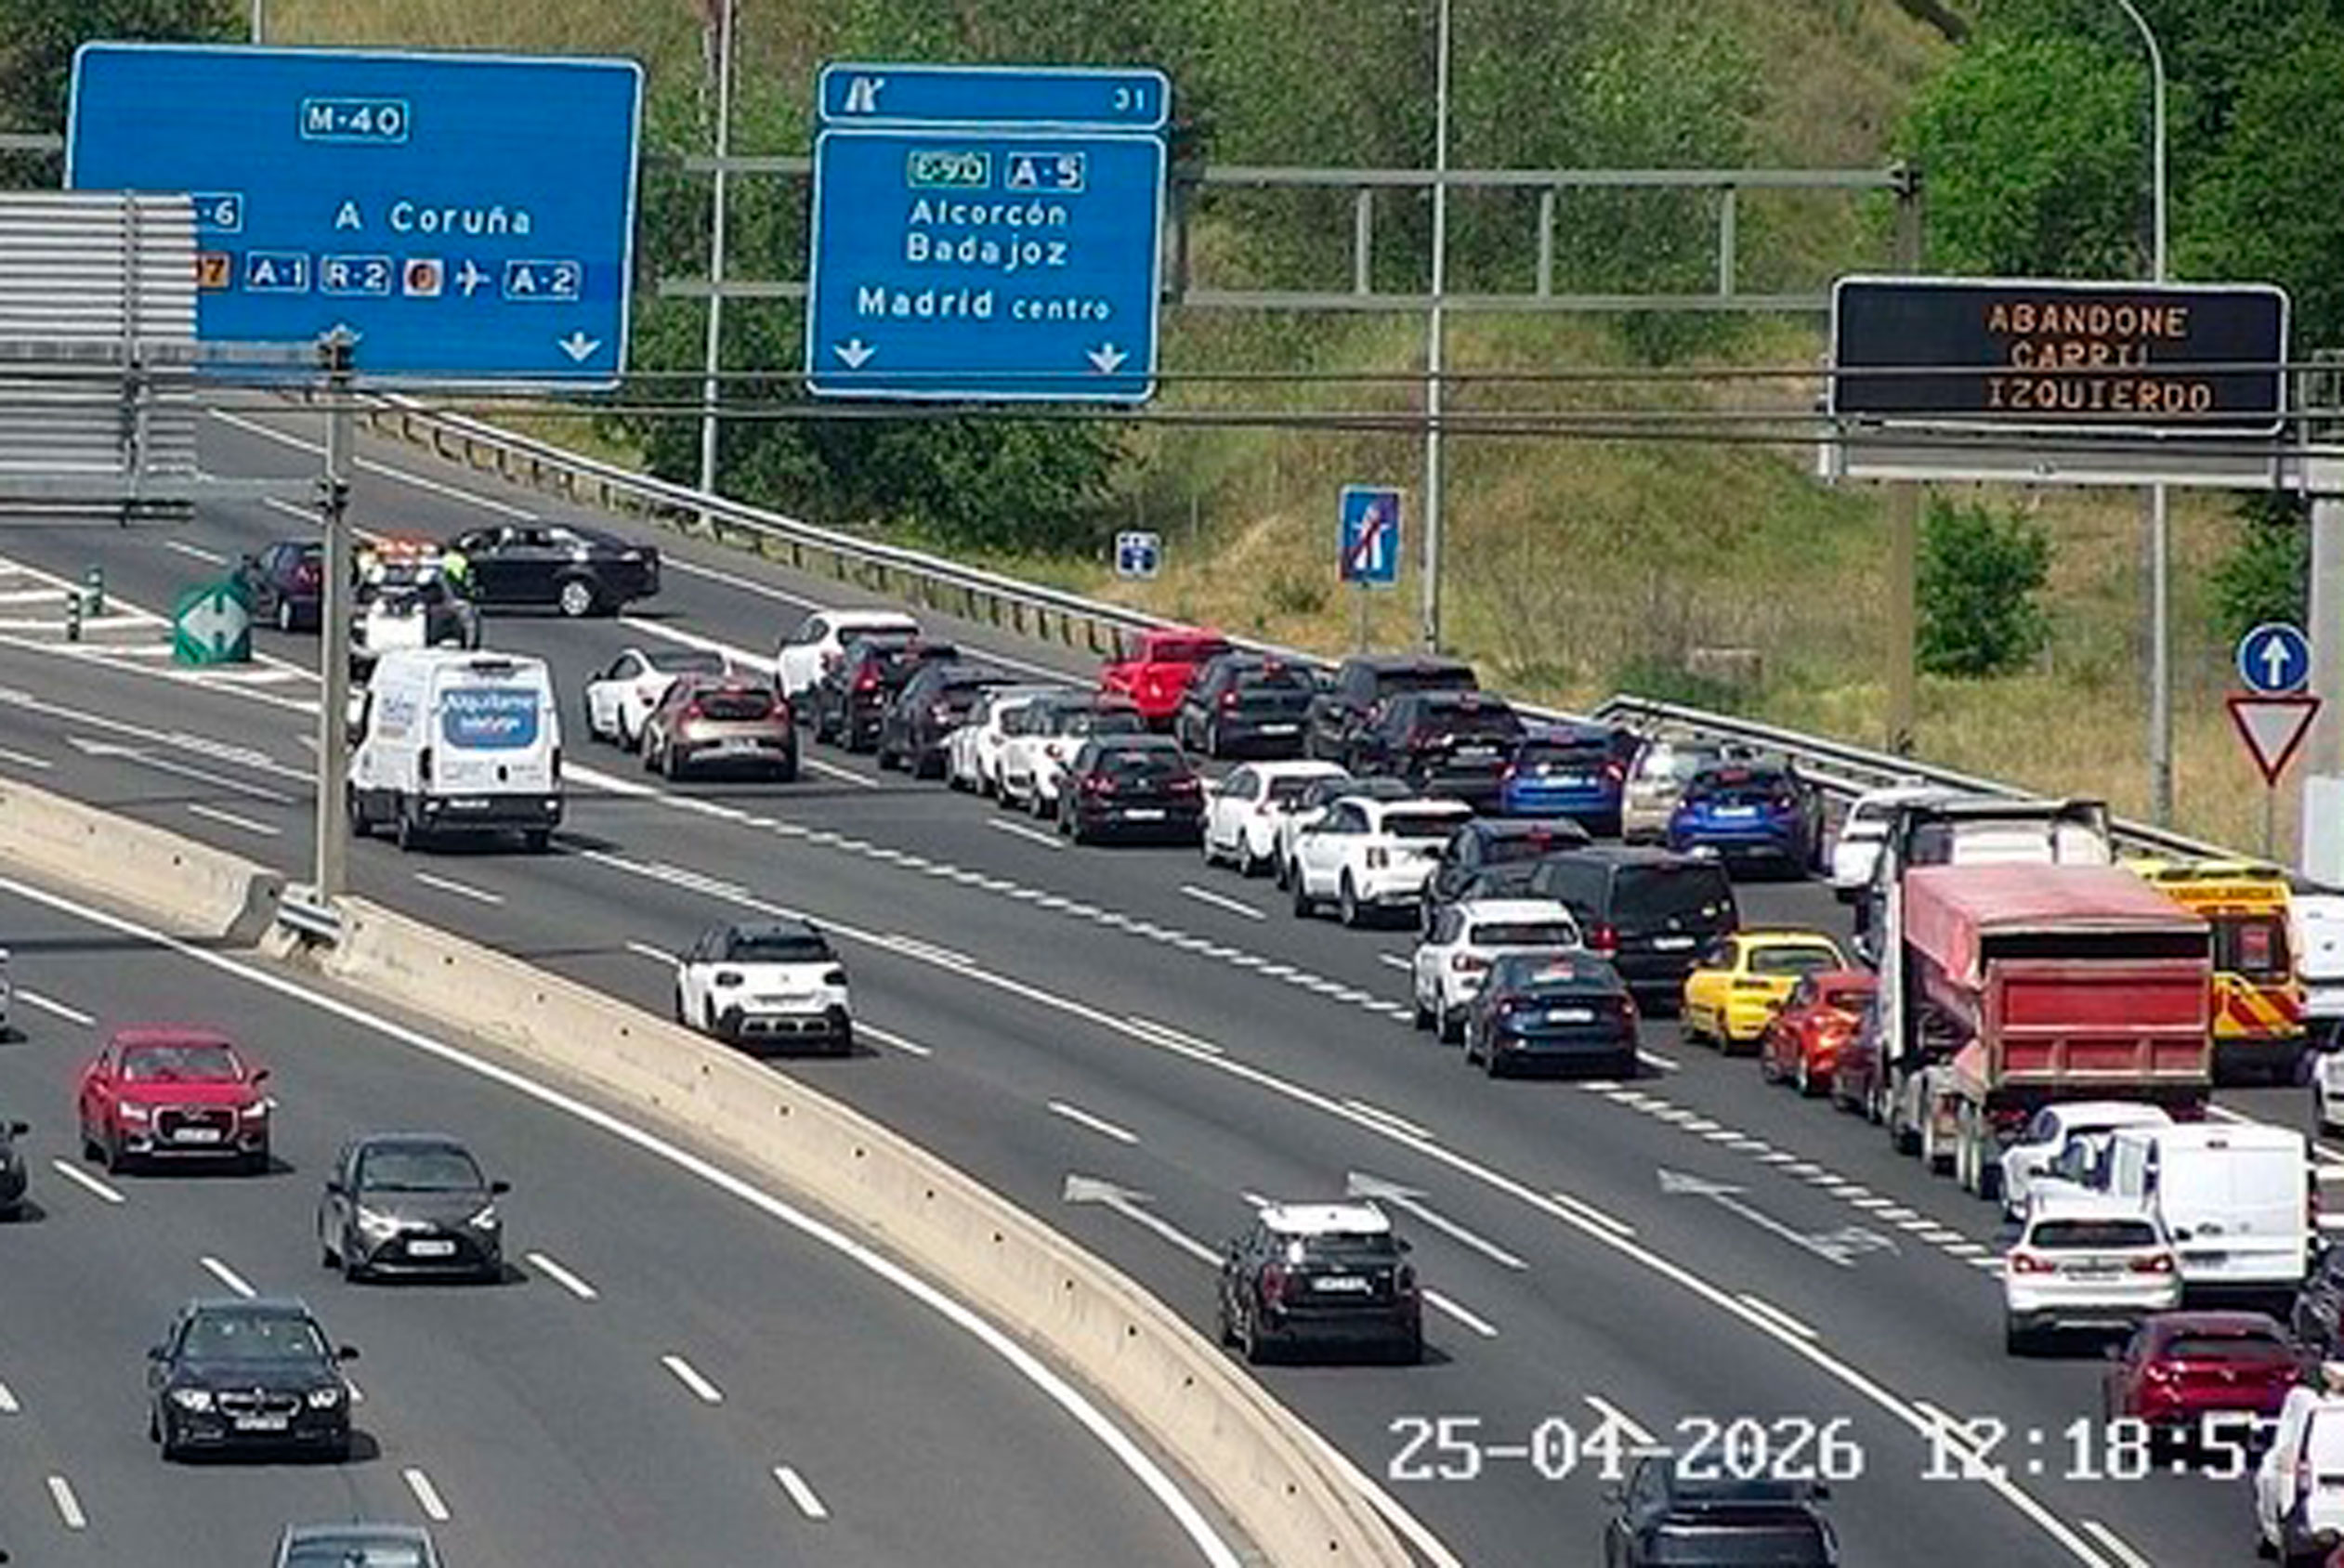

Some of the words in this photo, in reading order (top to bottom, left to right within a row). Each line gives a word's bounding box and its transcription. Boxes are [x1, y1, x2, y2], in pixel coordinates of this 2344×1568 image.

[1114, 88, 1144, 111] 31
[308, 106, 399, 136] M-40
[1011, 158, 1078, 188] A-5
[334, 201, 362, 230] A
[390, 201, 530, 234] Coruña
[909, 199, 1067, 227] Alcorcón
[907, 232, 1067, 272] Badajoz
[253, 258, 302, 286] A-1
[328, 262, 387, 288] R-2
[512, 267, 573, 294] A-2
[858, 287, 993, 319] Madrid
[1012, 295, 1111, 321] centro
[1988, 304, 2189, 336] ABANDONE
[1987, 377, 2212, 413] IZQUIERDO
